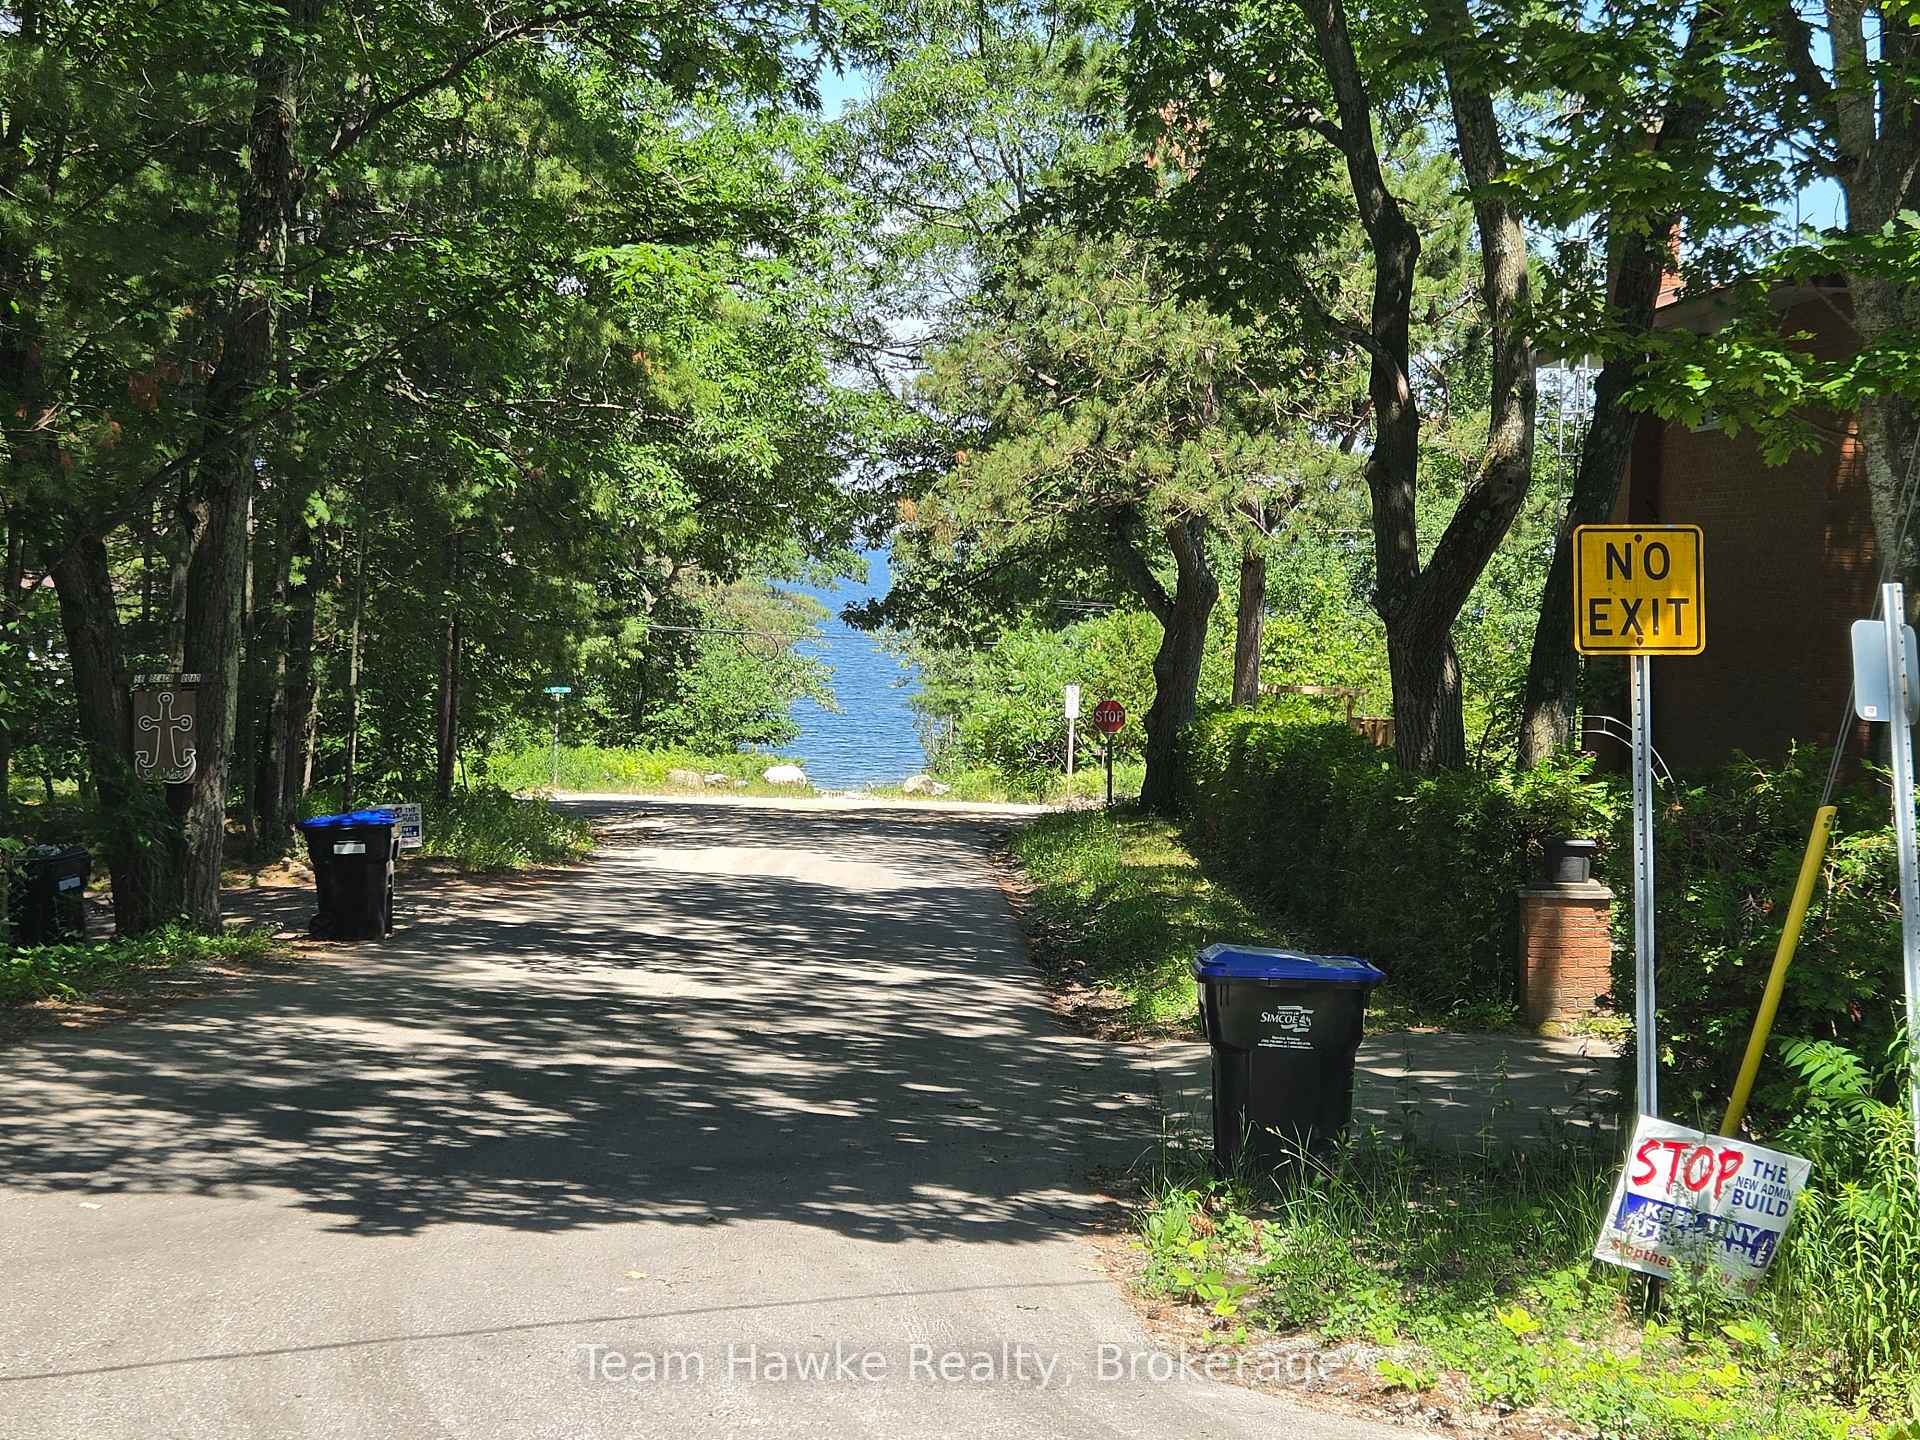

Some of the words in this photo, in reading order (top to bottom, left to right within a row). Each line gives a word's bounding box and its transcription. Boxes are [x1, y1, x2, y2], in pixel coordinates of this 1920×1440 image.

[1605, 541, 1671, 581] NO
[1588, 597, 1690, 636] EXIT
[1095, 710, 1124, 722] STOP
[1260, 1012, 1300, 1024] SIMCOE
[1631, 1138, 1744, 1200] STOP
[1753, 1159, 1788, 1185] THE
[1736, 1175, 1760, 1194] NEW
[1761, 1180, 1796, 1200] ADMIN
[1731, 1188, 1790, 1218] BUILD
